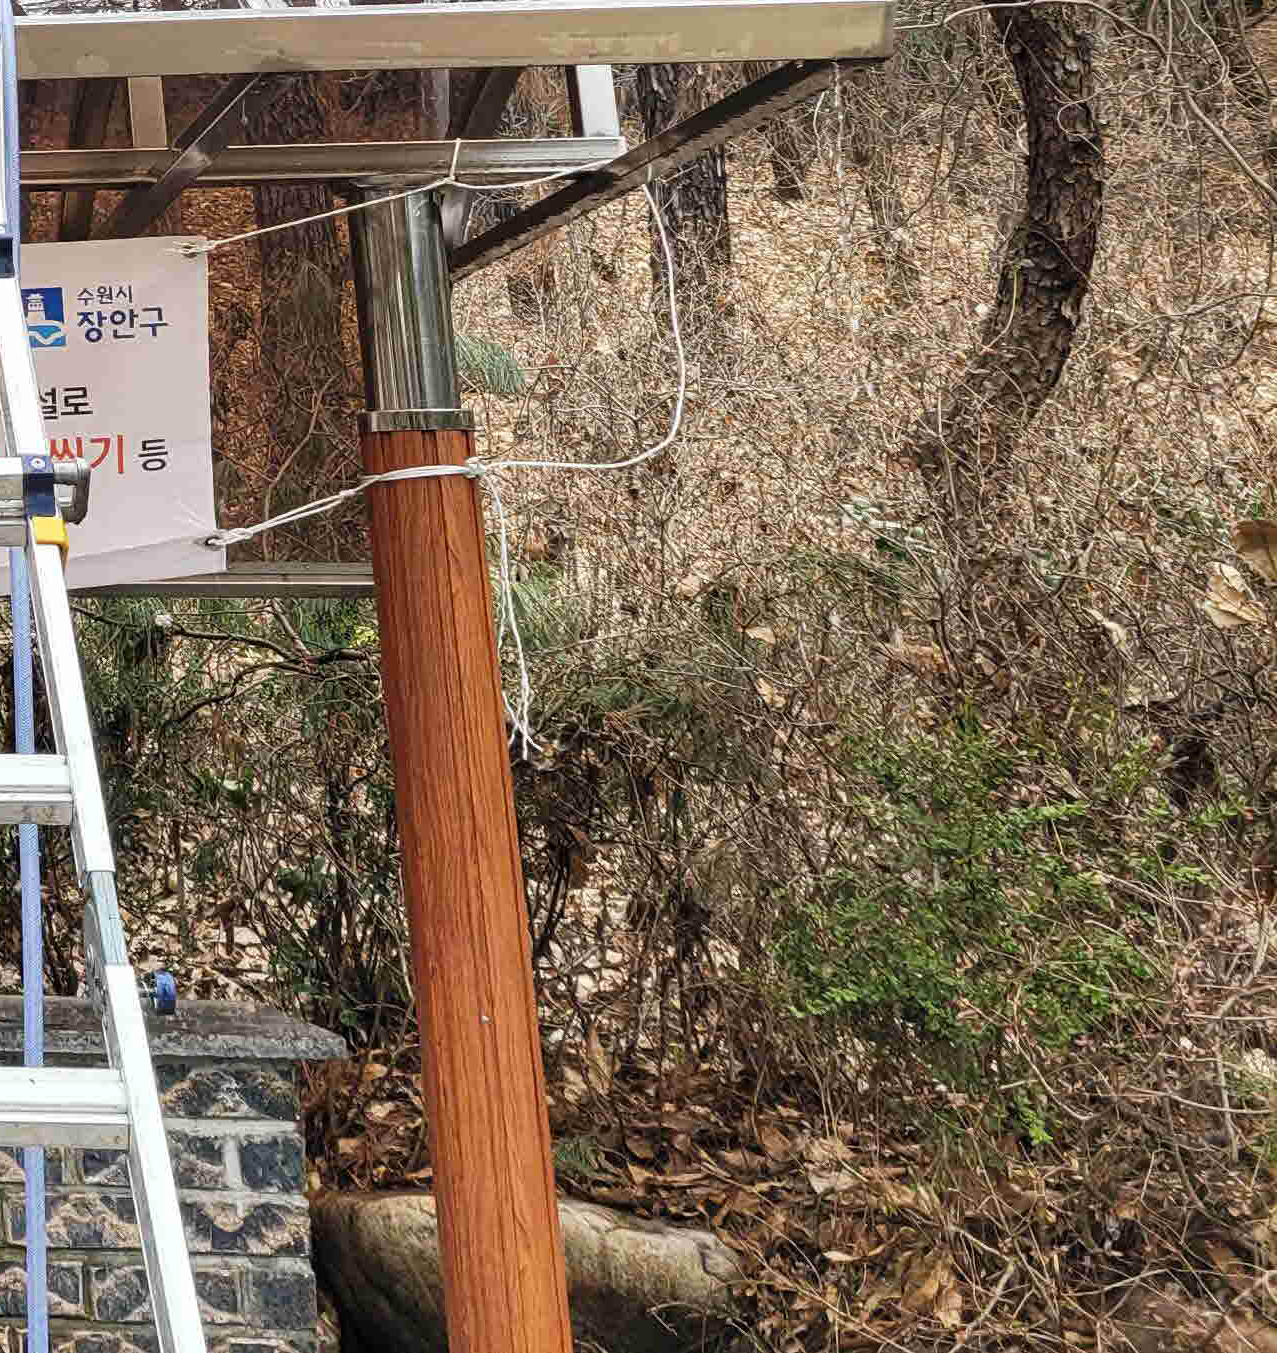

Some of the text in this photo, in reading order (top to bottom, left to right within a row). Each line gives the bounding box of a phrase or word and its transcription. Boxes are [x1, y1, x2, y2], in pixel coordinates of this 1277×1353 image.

[77, 285, 133, 306] 수원시
[77, 308, 169, 343] 장안구
[137, 438, 168, 471] 등
